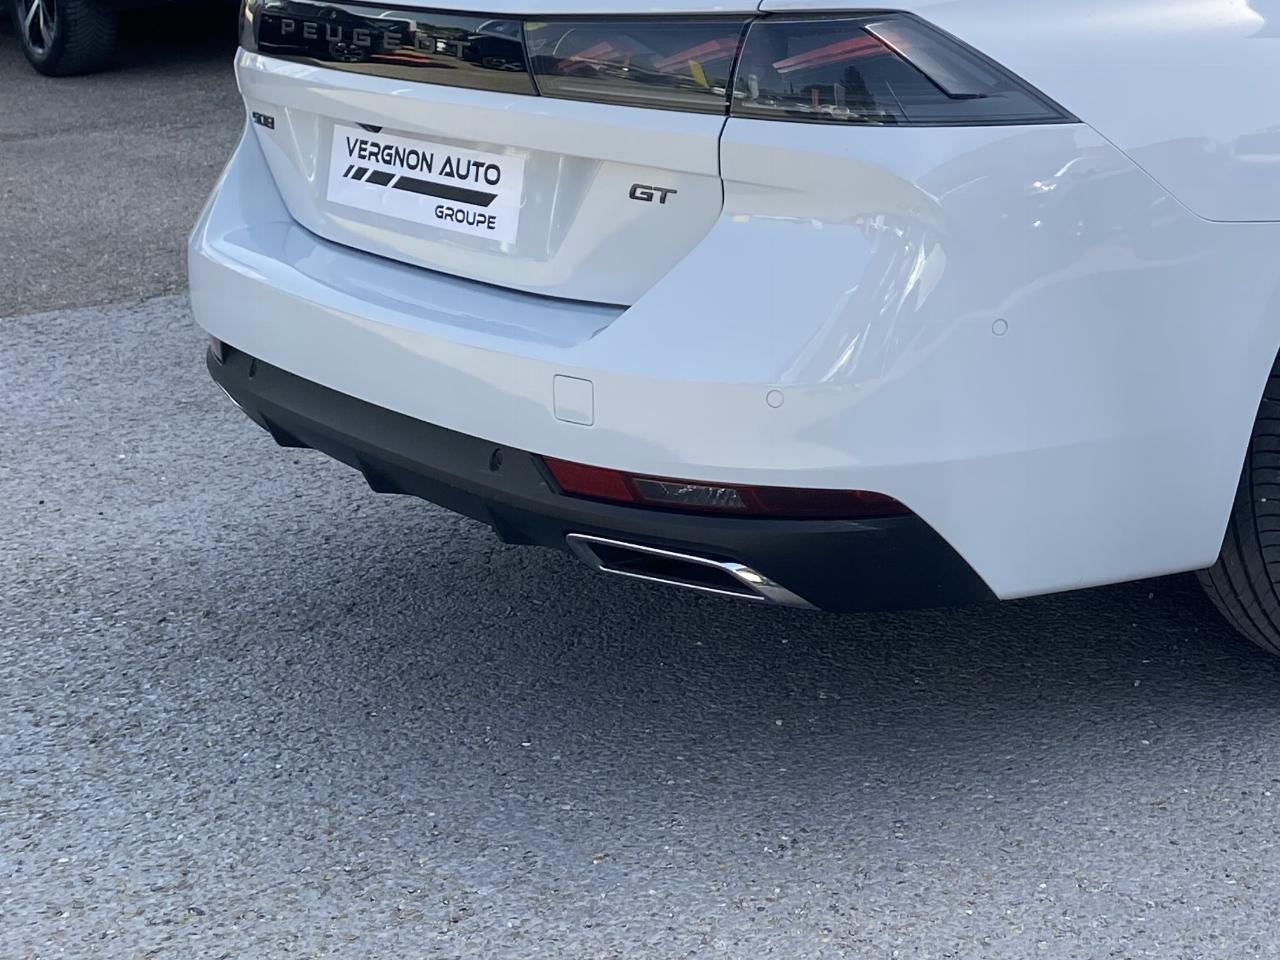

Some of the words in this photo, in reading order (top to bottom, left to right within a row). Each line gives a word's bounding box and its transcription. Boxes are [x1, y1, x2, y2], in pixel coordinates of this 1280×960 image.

[280, 18, 471, 58] PEUGEOT
[346, 136, 434, 174] VERGNON
[438, 155, 501, 186] AUTO
[628, 183, 678, 205] GT
[434, 204, 497, 230] GROUPE
